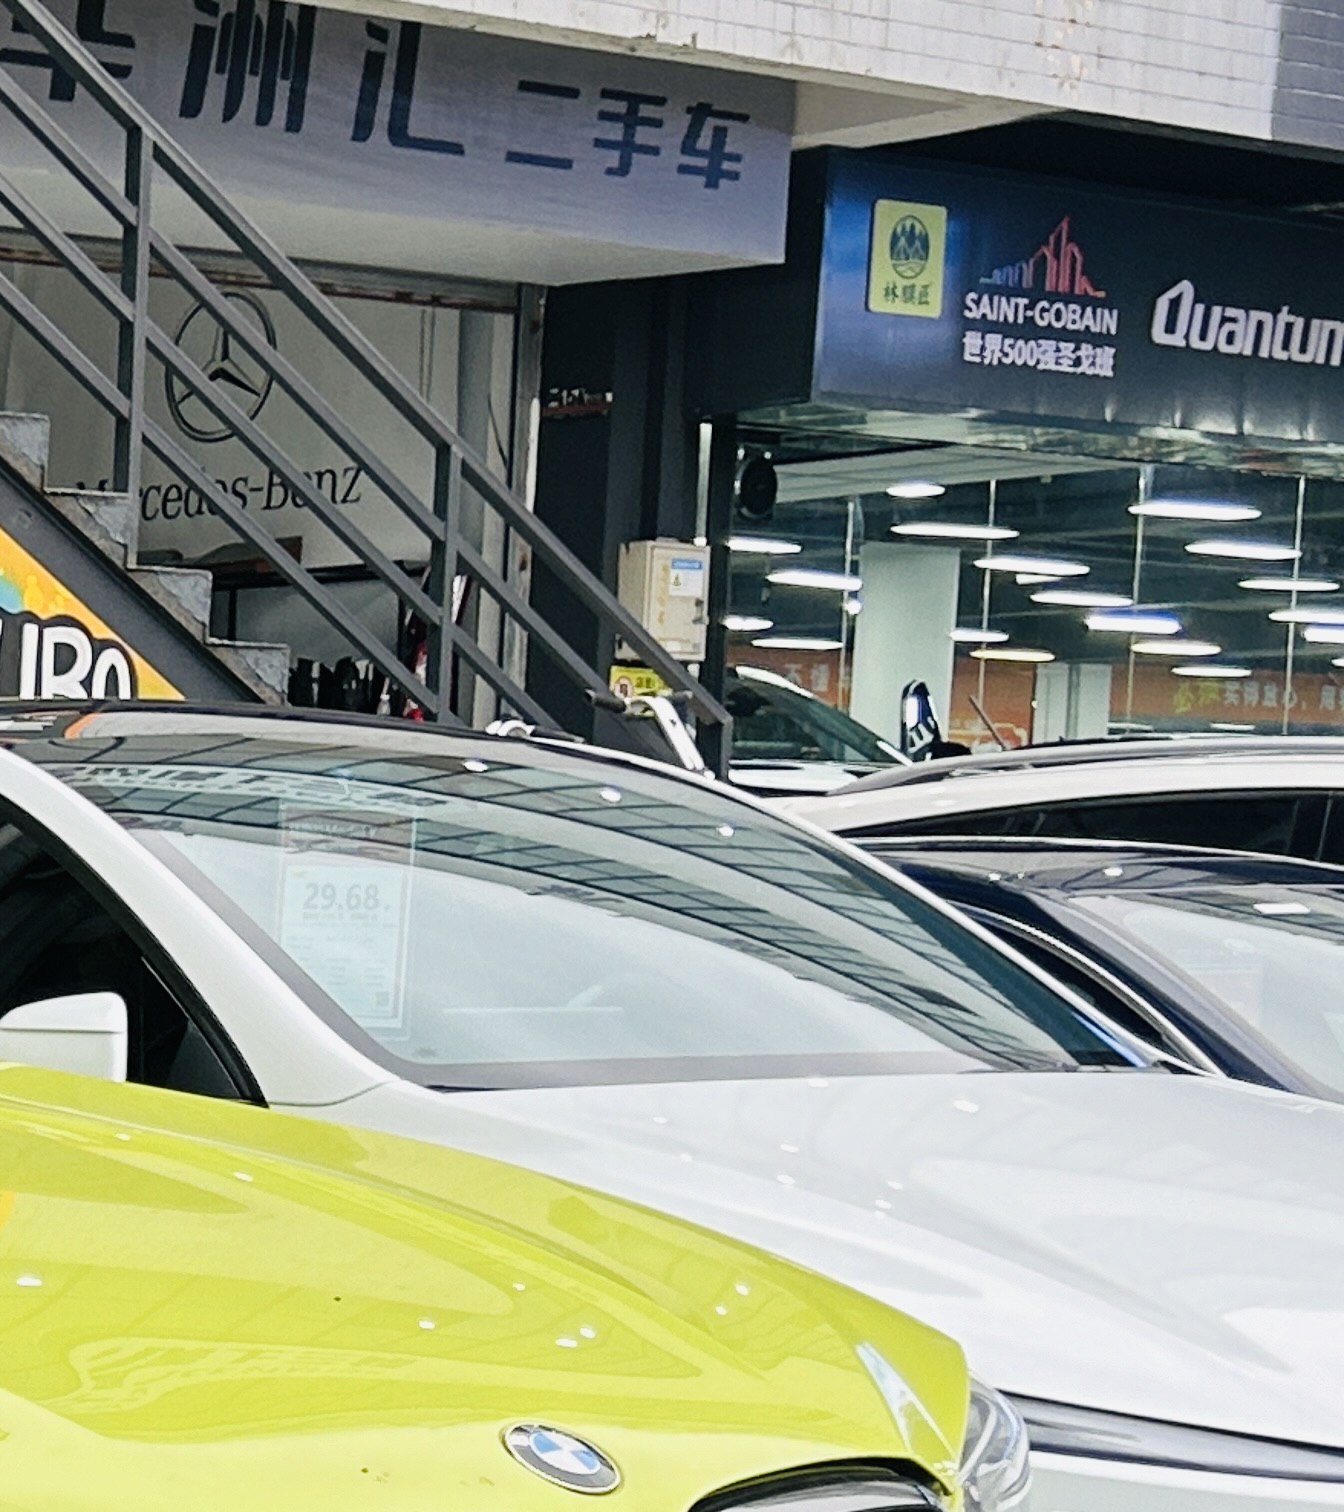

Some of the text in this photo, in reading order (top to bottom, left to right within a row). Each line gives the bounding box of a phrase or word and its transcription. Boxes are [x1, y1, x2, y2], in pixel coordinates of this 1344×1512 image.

[505, 79, 750, 189] 二手车
[963, 291, 1118, 335] SAINT-GOBAIN
[1151, 279, 1344, 366] Quantum
[962, 330, 1116, 378] 世界500强圣戈班
[76, 465, 363, 522] ceds-Bnz
